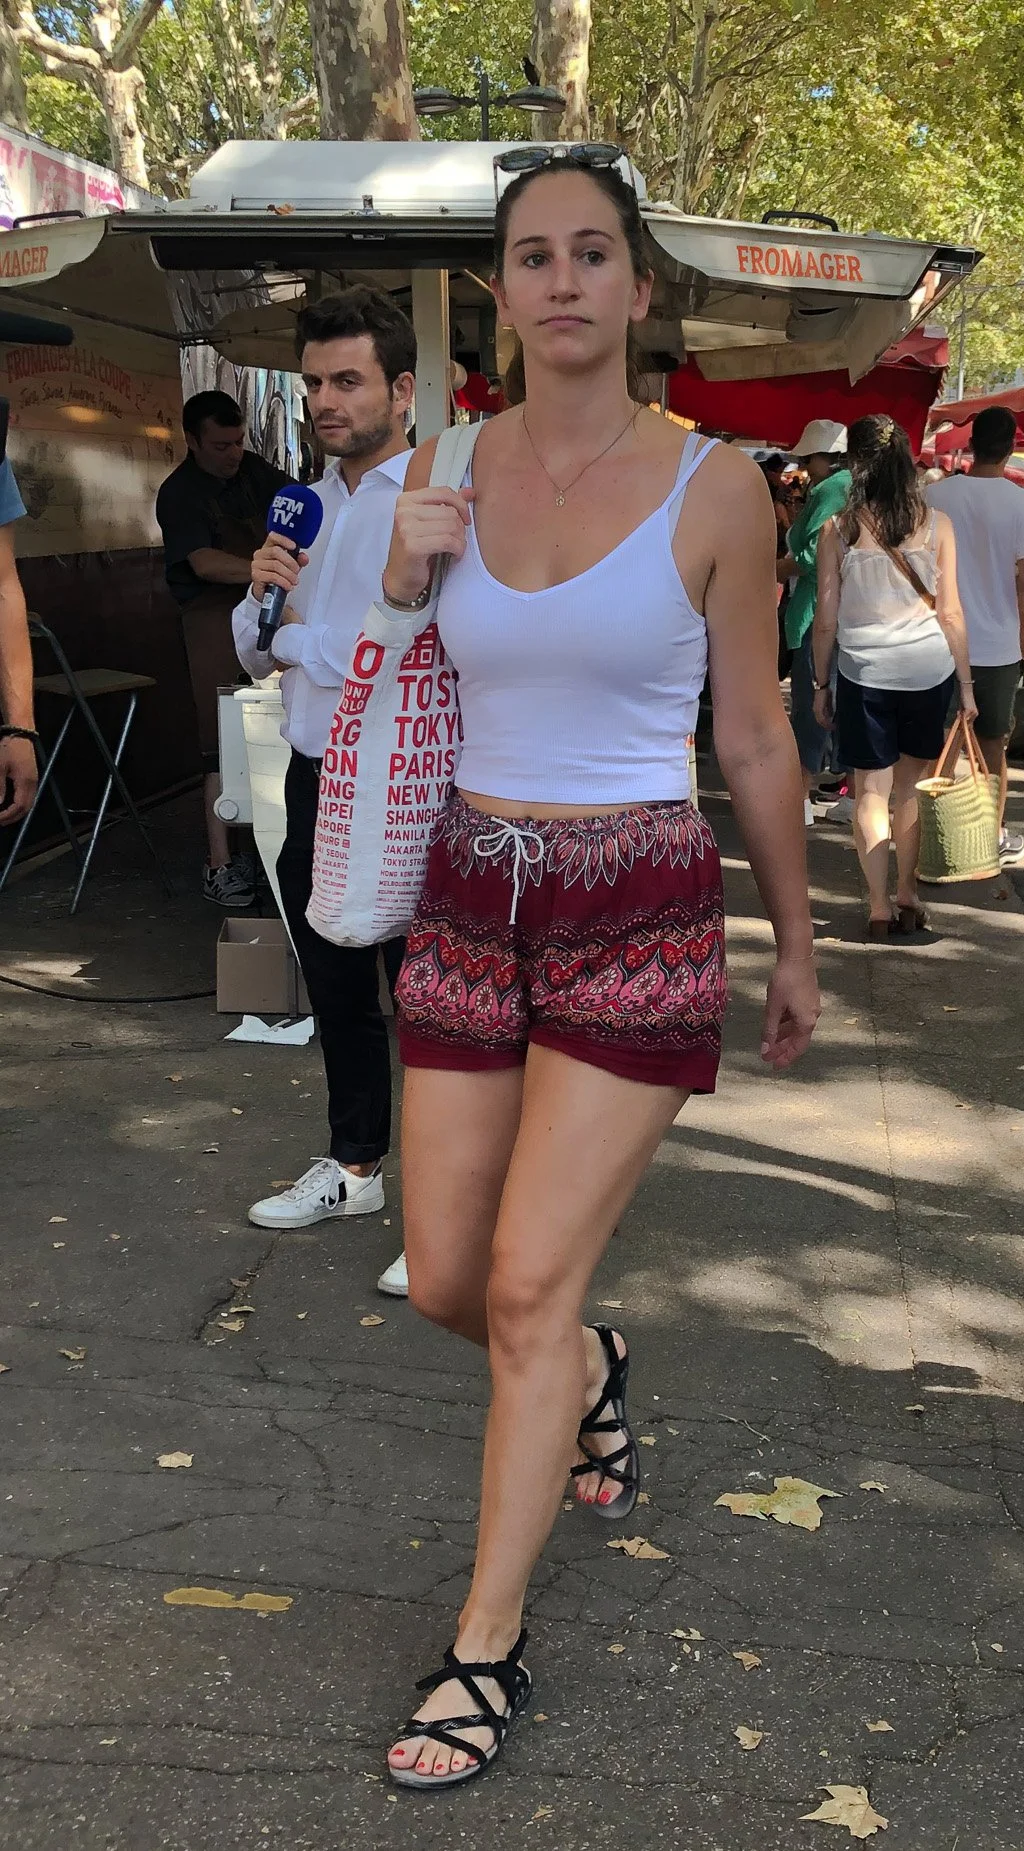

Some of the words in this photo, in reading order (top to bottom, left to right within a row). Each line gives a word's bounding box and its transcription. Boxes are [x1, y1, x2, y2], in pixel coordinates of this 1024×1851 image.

[736, 245, 863, 282] FROMAGER
[272, 495, 304, 515] BFM
[345, 682, 368, 699] UNI
[341, 698, 364, 712] QLO
[324, 748, 358, 777] ON
[389, 749, 456, 780] PARIS
[320, 775, 355, 800] ONG
[387, 783, 430, 806] NEW
[384, 829, 426, 842] MANILA
[326, 848, 350, 860] SEOUL
[383, 844, 423, 855] JAKARTA
[382, 857, 407, 867] TOKYO
